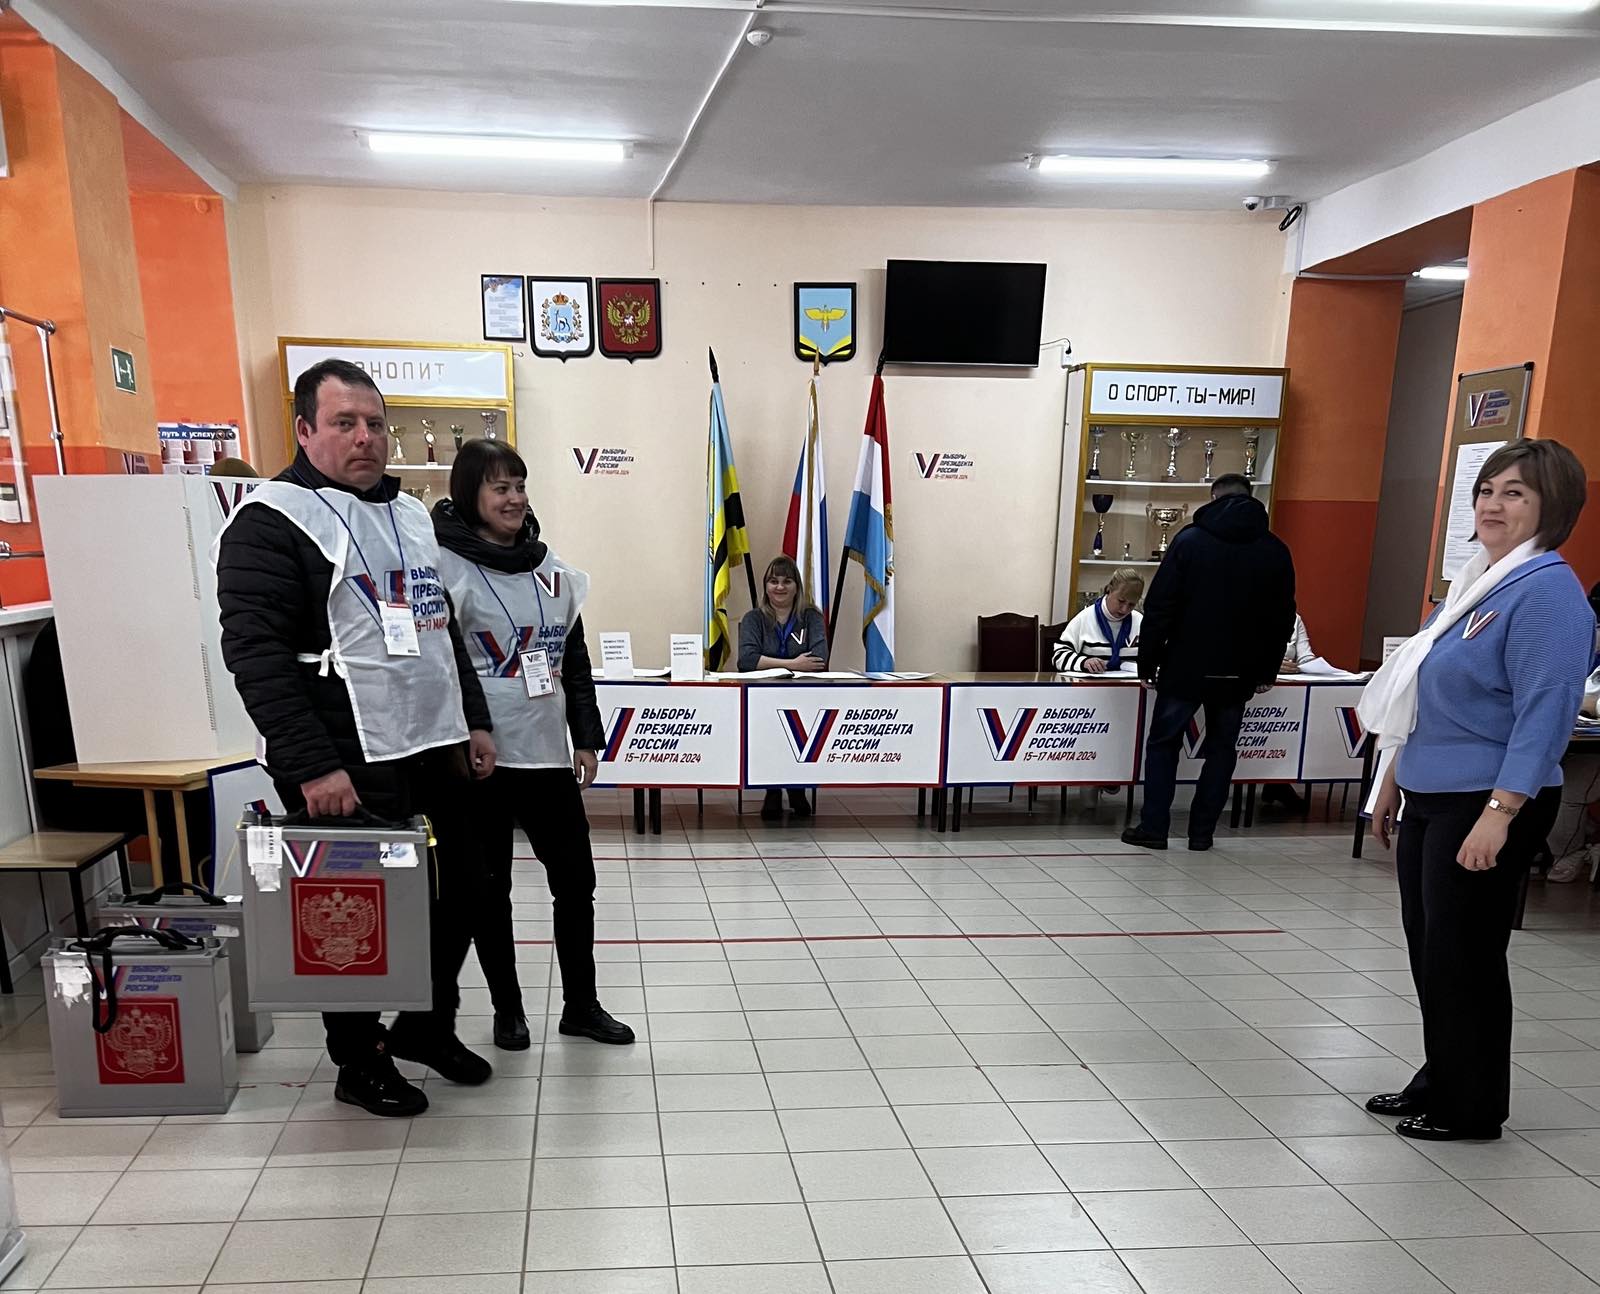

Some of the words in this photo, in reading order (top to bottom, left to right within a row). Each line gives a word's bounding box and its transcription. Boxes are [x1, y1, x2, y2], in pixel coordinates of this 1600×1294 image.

[1108, 384, 1119, 400] О
[1125, 384, 1180, 404] СПОРТ,
[641, 708, 697, 720] ВЫБОРЫ
[844, 709, 899, 720] ВЫБОРЫ
[1042, 708, 1096, 719] ВЫБОРЫ
[1243, 707, 1287, 718] ЫБОРЫ
[635, 723, 712, 737] ПРЕЗИДЕНТА
[838, 724, 914, 736] ПРЕЗИДЕНТА
[1035, 723, 1110, 735] ПРЕЗИДЕНТА
[1239, 721, 1300, 733] РЕЗИДЕНТА
[628, 738, 679, 750] РОССИИ
[831, 738, 881, 750] РОССИИ
[1028, 737, 1077, 749] РОССИИ
[650, 753, 679, 764] МАРТА
[680, 753, 701, 763] 2024
[851, 753, 880, 763] МАРТА
[881, 752, 901, 763] 2024
[1047, 752, 1076, 761] МАРТА
[1076, 751, 1097, 761] 2024
[1239, 750, 1266, 759] МАРТА
[1266, 749, 1287, 759] 2024
